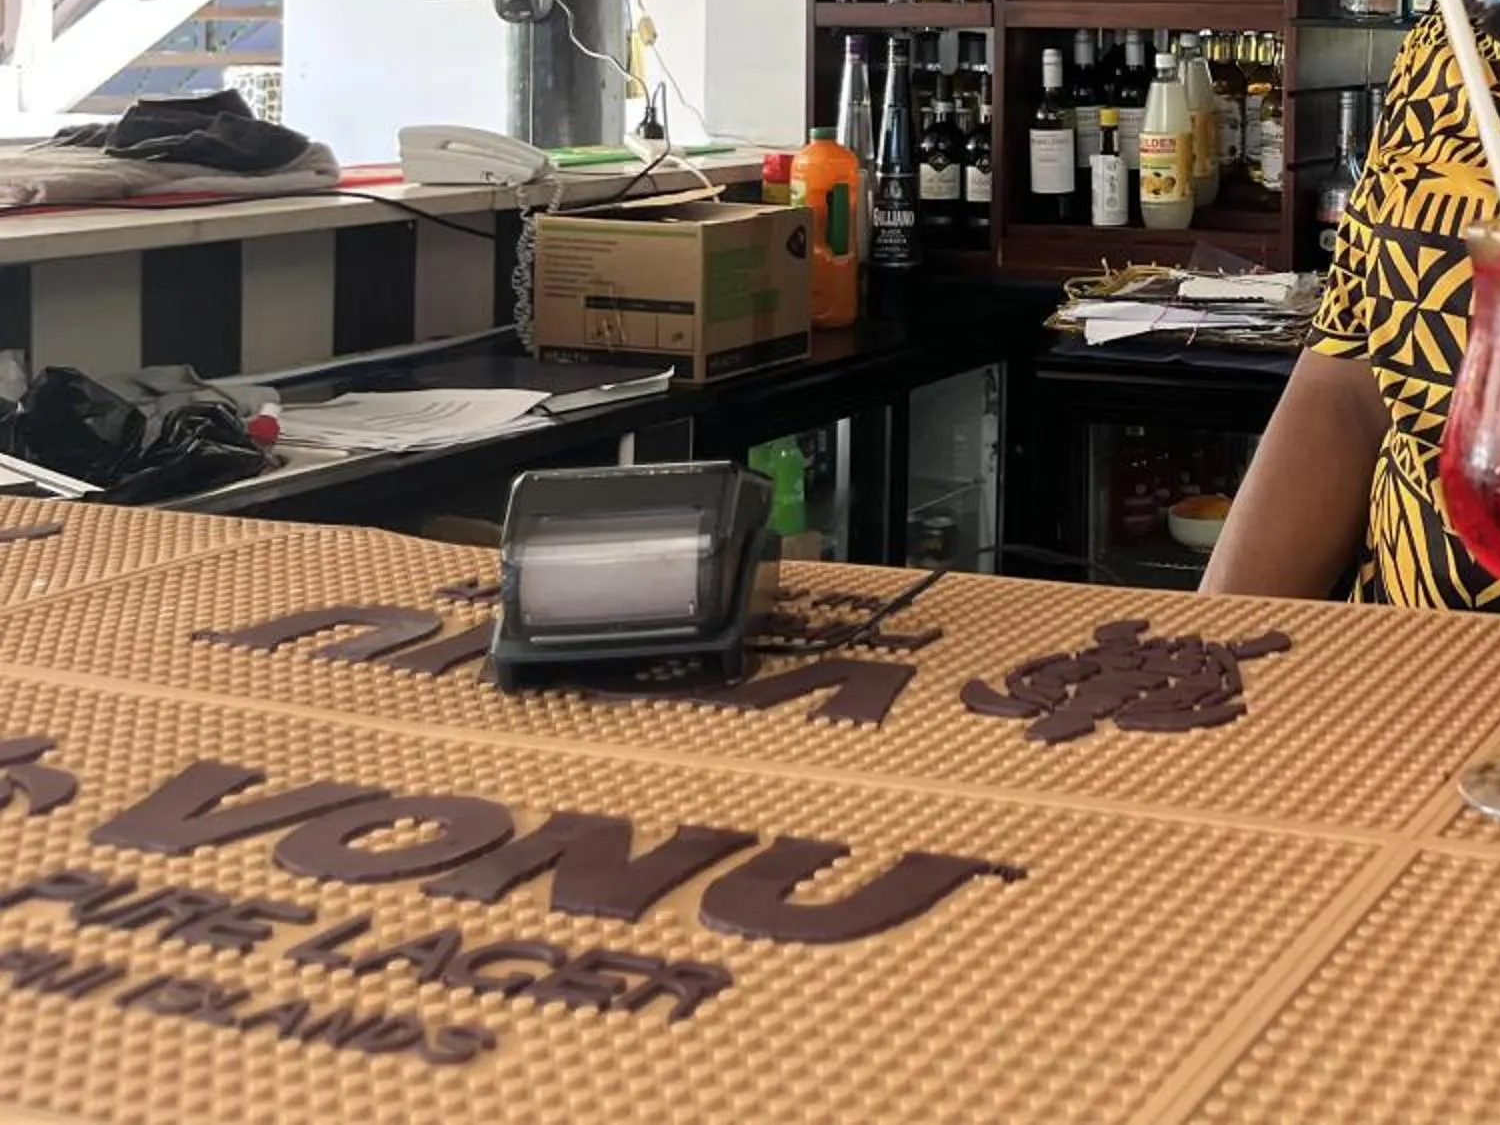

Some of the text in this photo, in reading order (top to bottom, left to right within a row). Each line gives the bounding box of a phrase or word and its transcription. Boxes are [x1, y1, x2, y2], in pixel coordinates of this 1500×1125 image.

[88, 759, 1028, 946] VONU
[0, 869, 734, 1023] PURE LAGER
[114, 973, 498, 1065] ISLANDS
